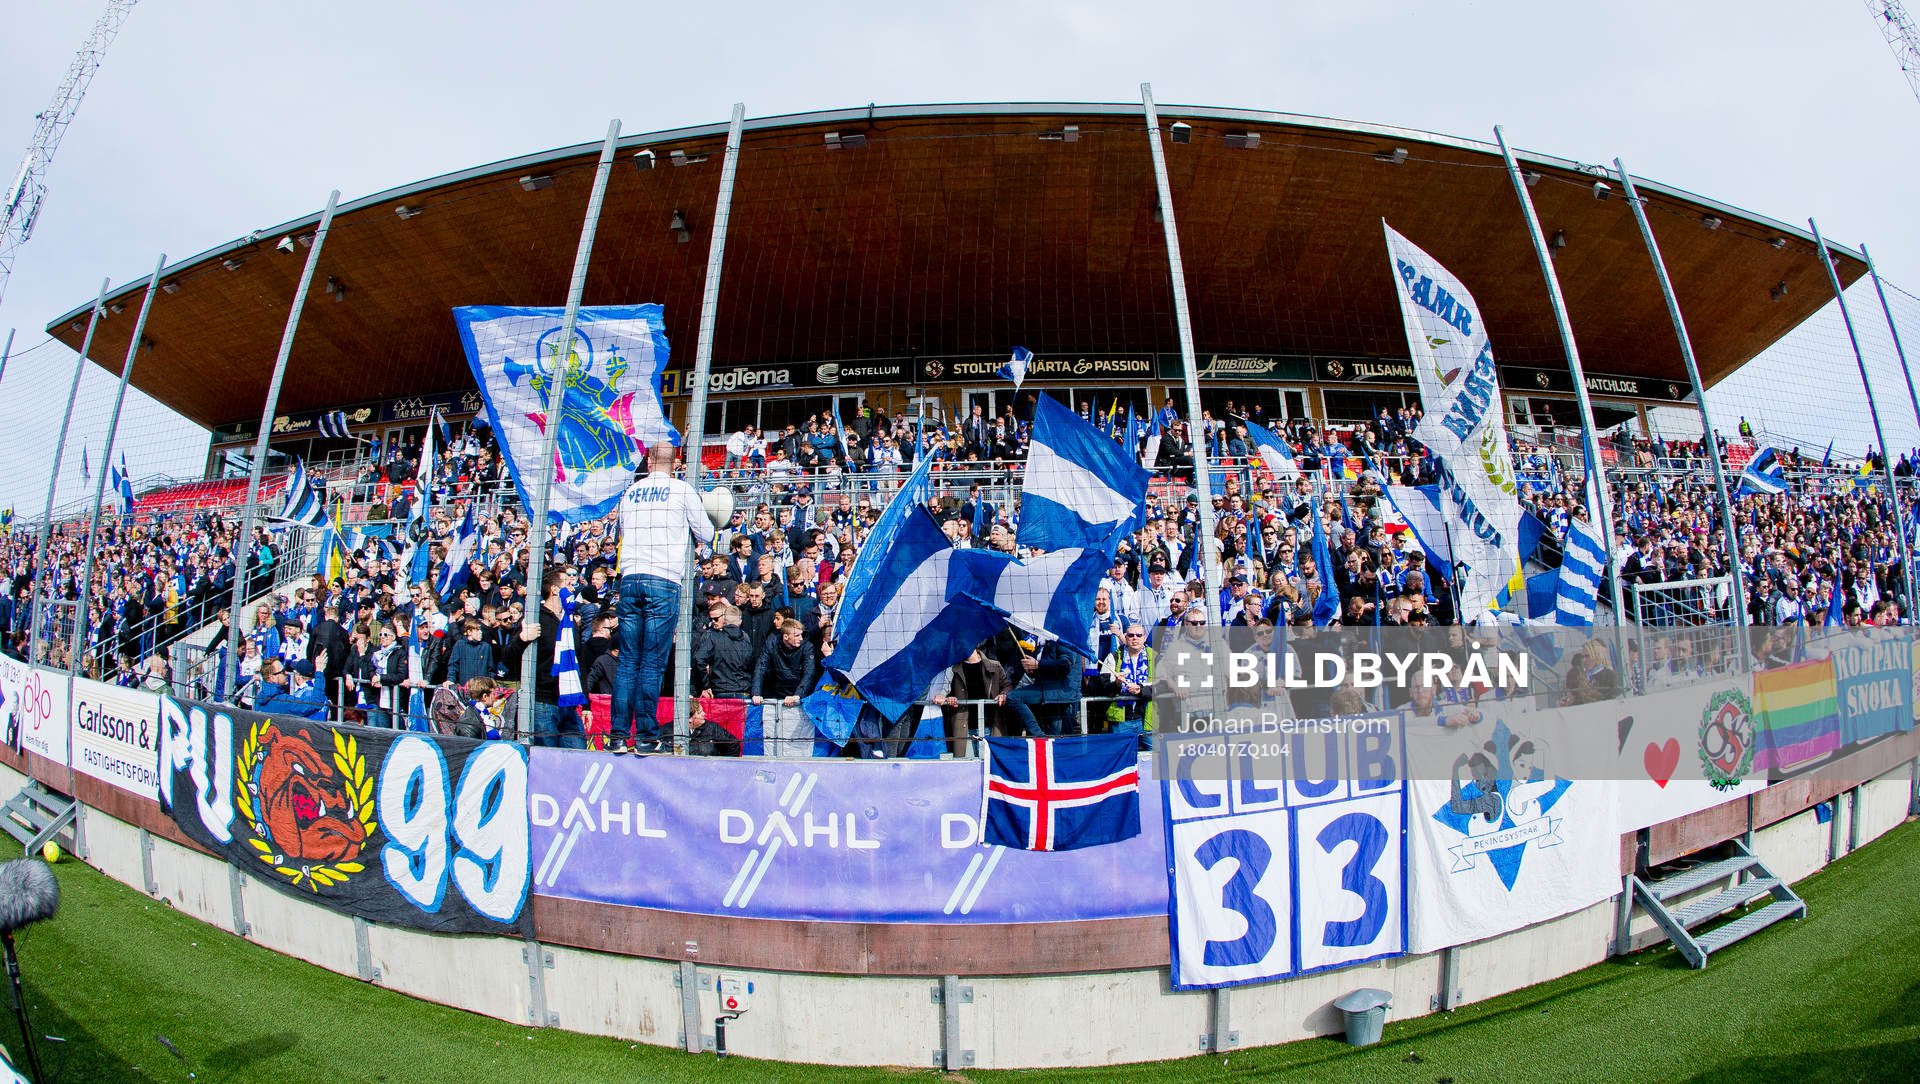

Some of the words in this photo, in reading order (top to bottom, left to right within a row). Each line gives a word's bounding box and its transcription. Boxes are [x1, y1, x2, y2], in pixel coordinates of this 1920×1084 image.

[685, 367, 790, 391] BggTema
[841, 366, 900, 377] CASTELLUM
[1073, 359, 1093, 374] &
[1095, 361, 1150, 372] PASSION
[629, 486, 670, 503] PEKING
[1835, 641, 1909, 681] KOMPANI
[1847, 678, 1903, 718] SNOKA
[78, 701, 135, 744] Carlsson
[139, 719, 150, 750] &
[1176, 728, 1396, 808] CLUB
[376, 732, 534, 924] 99
[531, 793, 667, 838] DAHL
[719, 808, 881, 849] DAHL
[1193, 812, 1389, 966] 33
